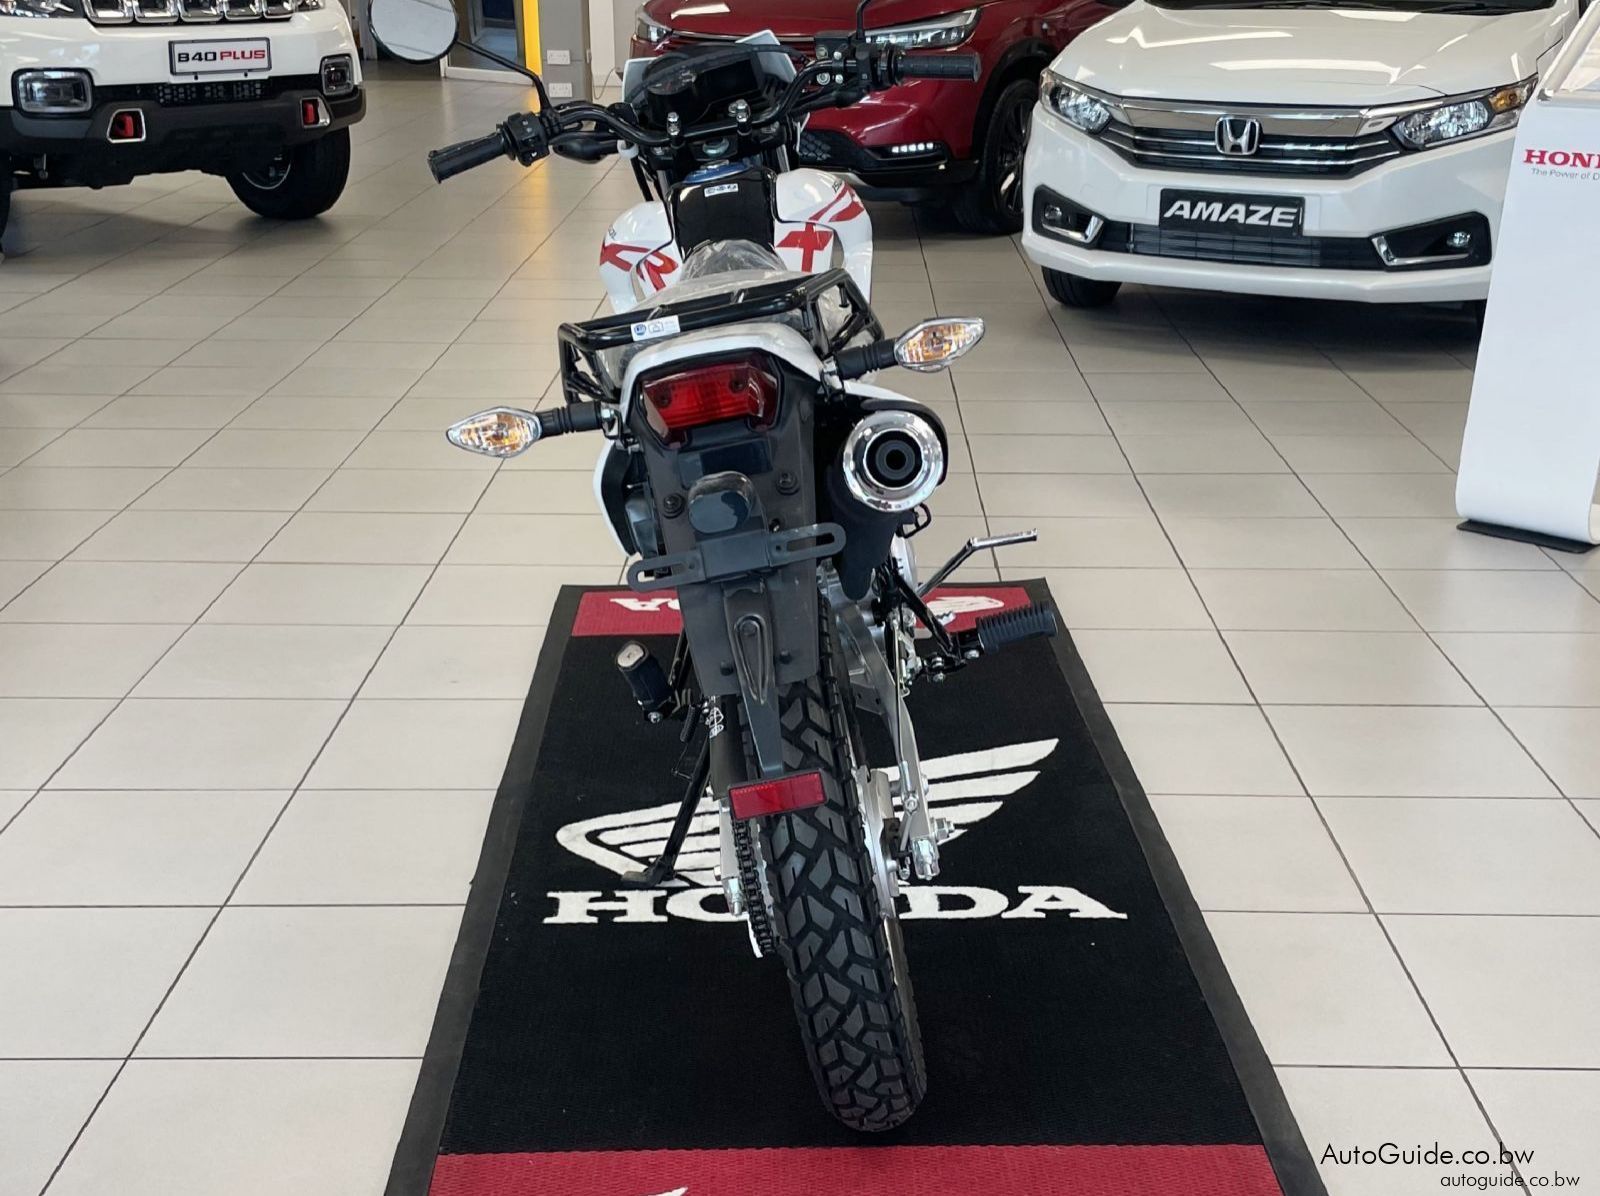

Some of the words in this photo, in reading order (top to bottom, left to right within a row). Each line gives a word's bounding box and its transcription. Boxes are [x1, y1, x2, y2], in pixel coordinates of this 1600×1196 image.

[1523, 149, 1600, 169] HON
[1531, 167, 1547, 175] The
[1550, 169, 1578, 179] Power
[1163, 200, 1298, 228] AMAZE
[542, 886, 1128, 923] HODA
